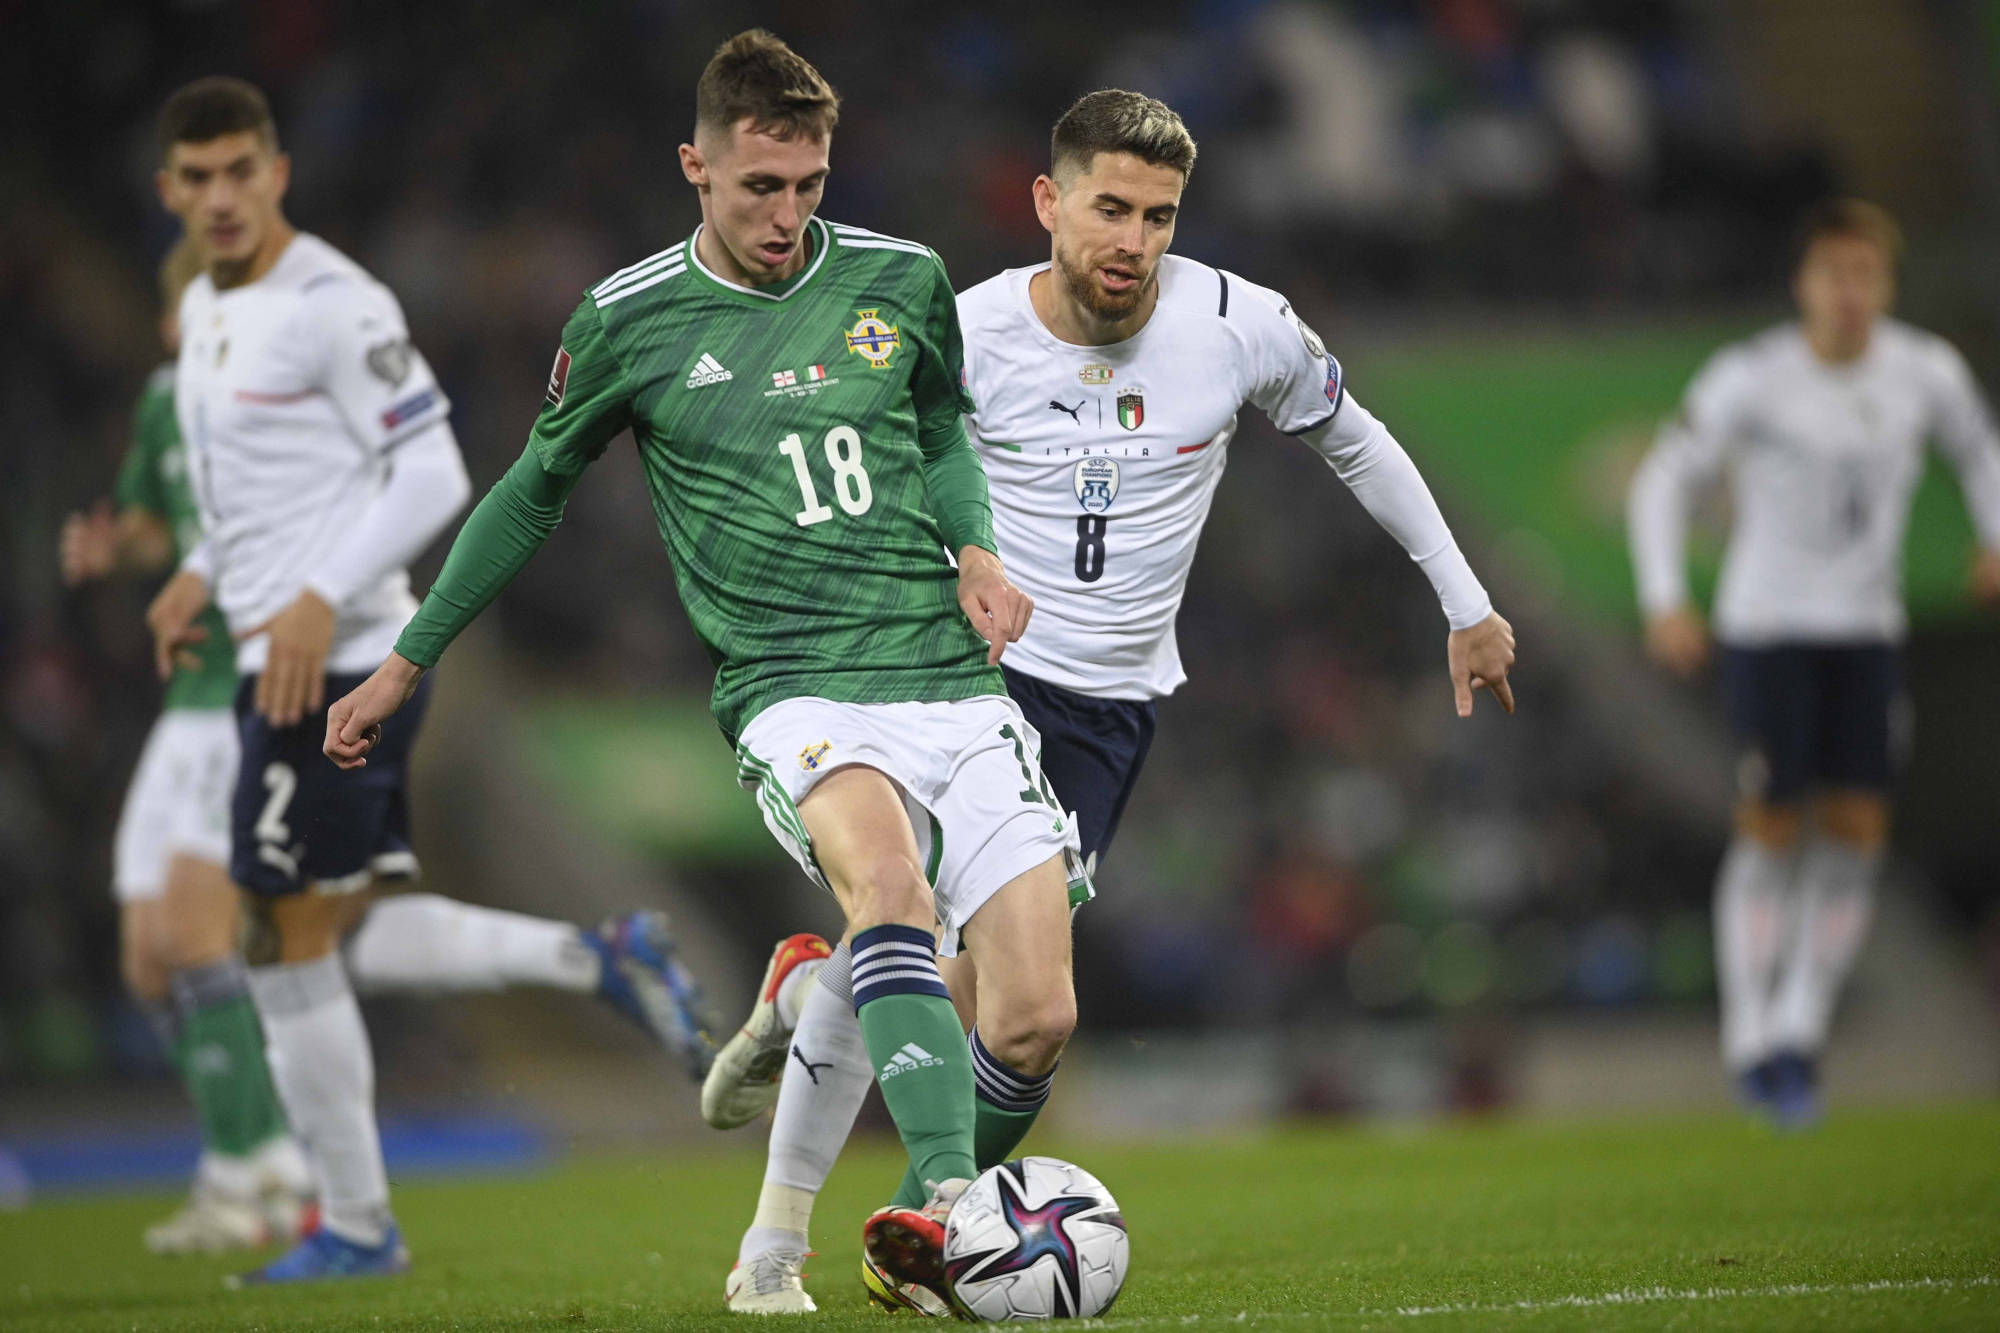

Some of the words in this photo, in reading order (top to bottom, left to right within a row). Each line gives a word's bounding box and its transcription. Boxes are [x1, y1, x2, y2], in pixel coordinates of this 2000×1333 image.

[686, 370, 733, 389] adidas
[1046, 447, 1149, 456] ITALIA
[778, 425, 873, 527] 18
[1074, 513, 1107, 583] 8
[254, 761, 299, 842] 2
[880, 1057, 944, 1081] adidas
